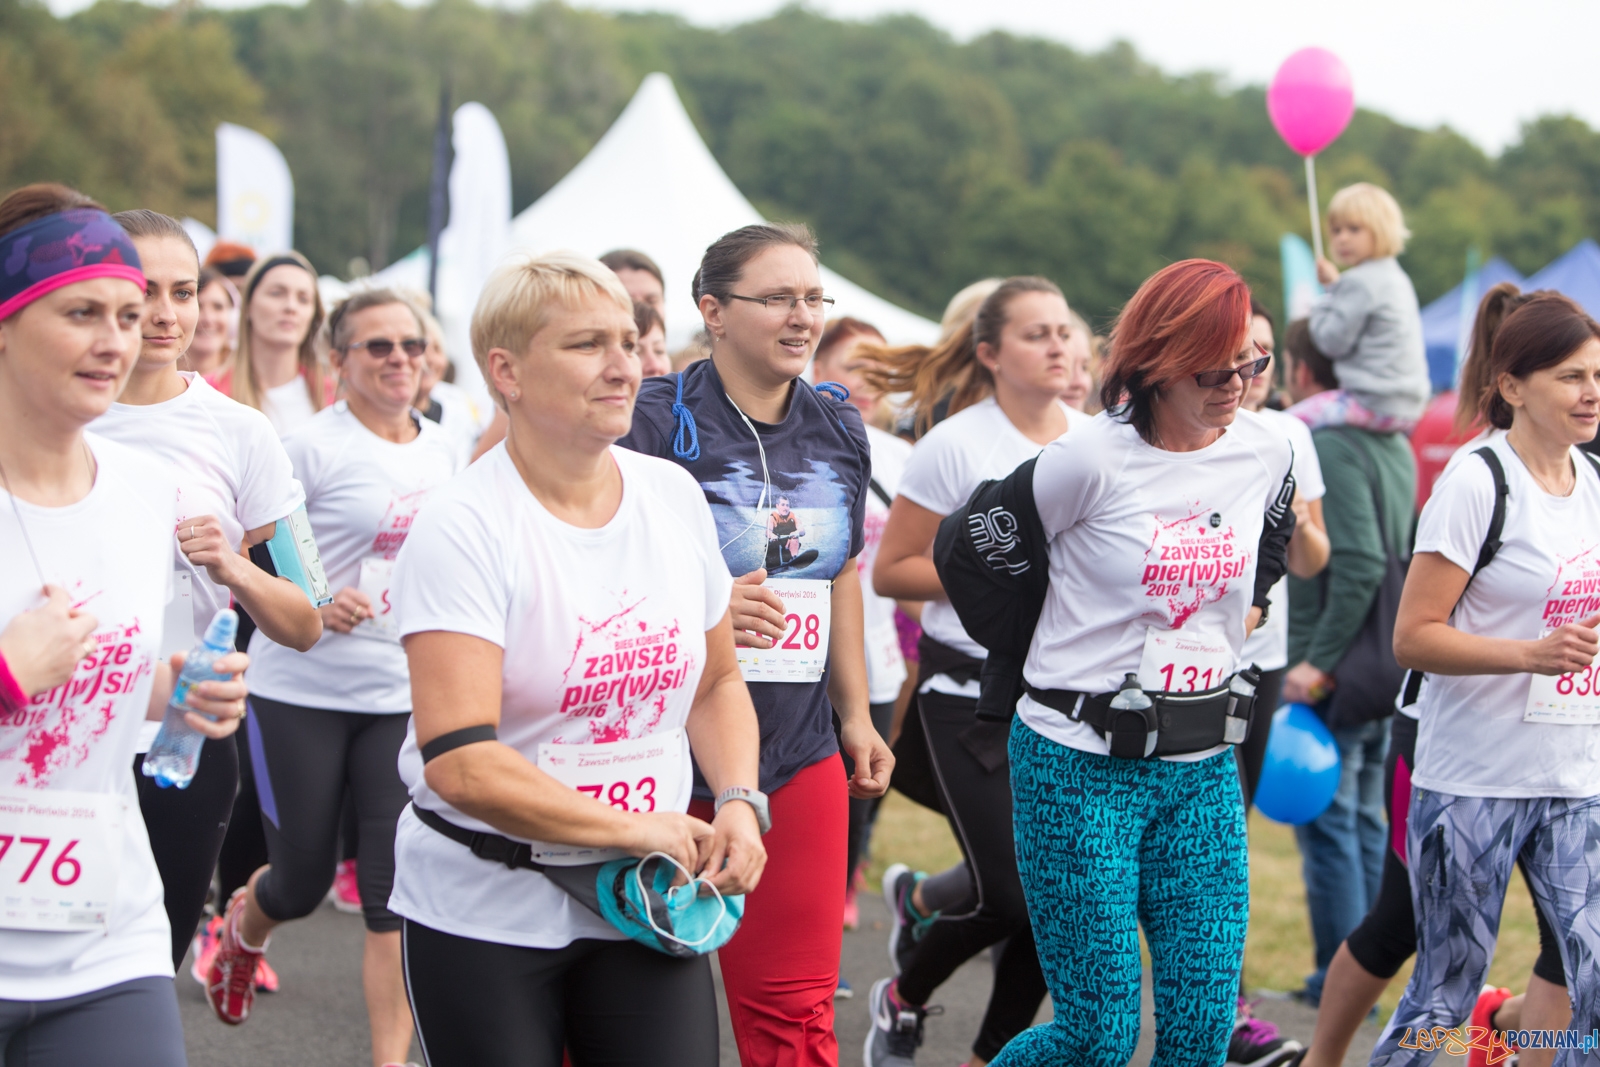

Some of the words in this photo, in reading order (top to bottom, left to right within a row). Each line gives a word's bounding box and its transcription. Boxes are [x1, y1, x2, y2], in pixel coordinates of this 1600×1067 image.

[1160, 543, 1234, 561] zawsze
[802, 590, 817, 599] 2016
[1146, 583, 1181, 597] 2016
[614, 638, 634, 651] BIEG
[635, 632, 665, 647] KOBIET
[583, 643, 677, 679] zawsze
